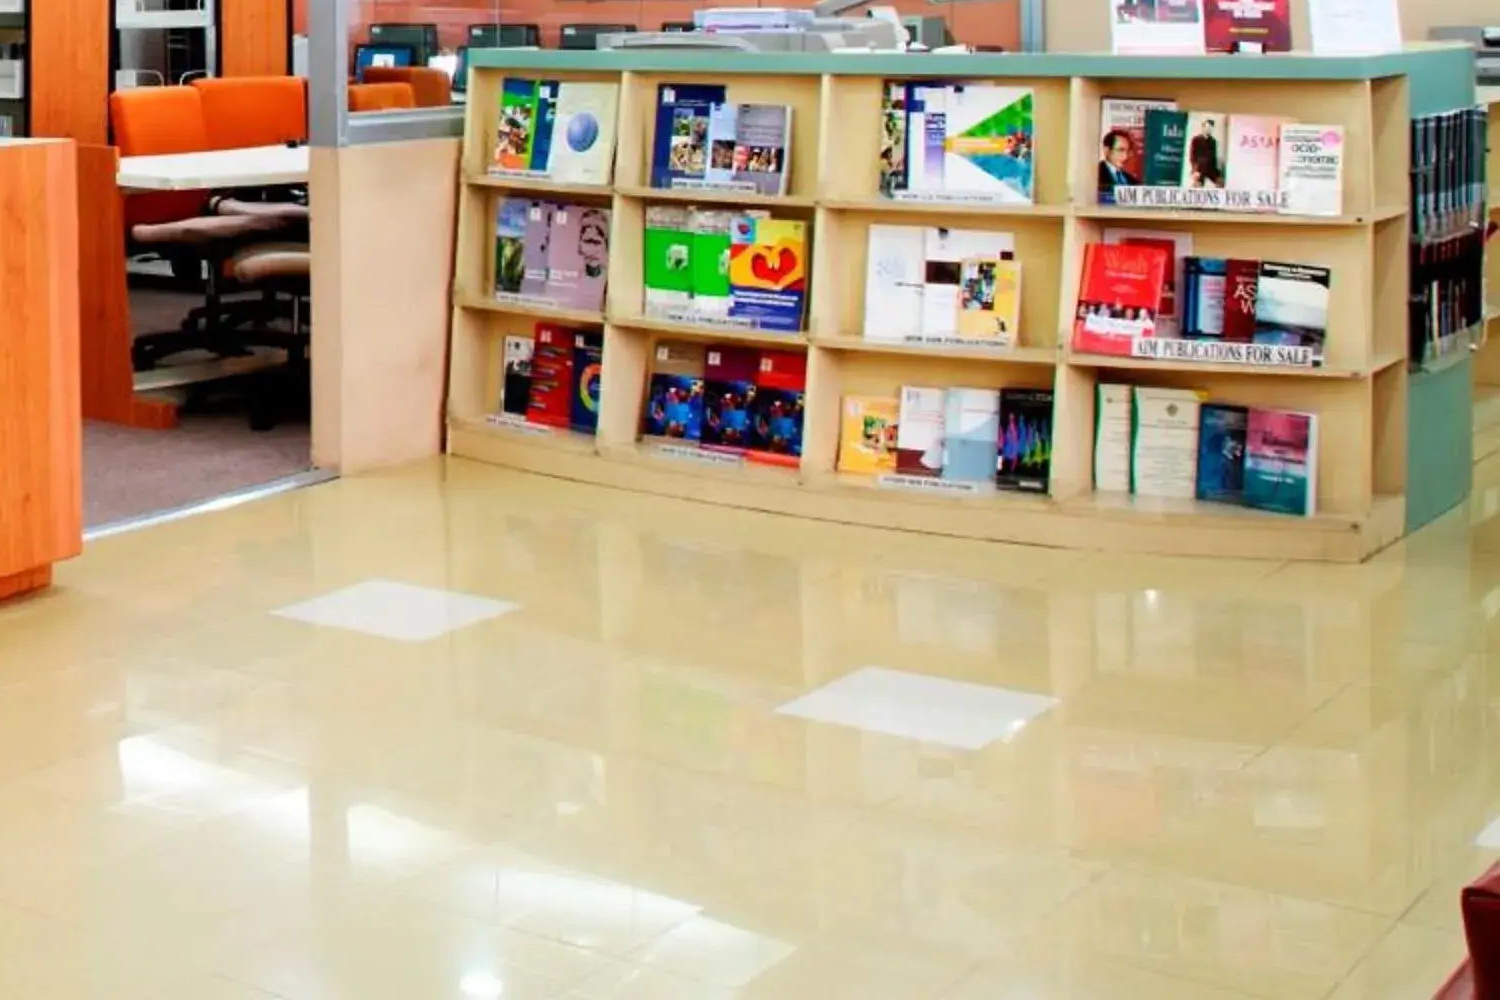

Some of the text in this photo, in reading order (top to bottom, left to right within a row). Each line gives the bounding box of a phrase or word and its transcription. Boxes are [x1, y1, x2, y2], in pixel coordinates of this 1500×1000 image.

[1116, 186, 1290, 209] AIM PUBLICATIONS FOR SALE
[1136, 340, 1311, 365] AIM PUBLICATIONS FOR SALE
